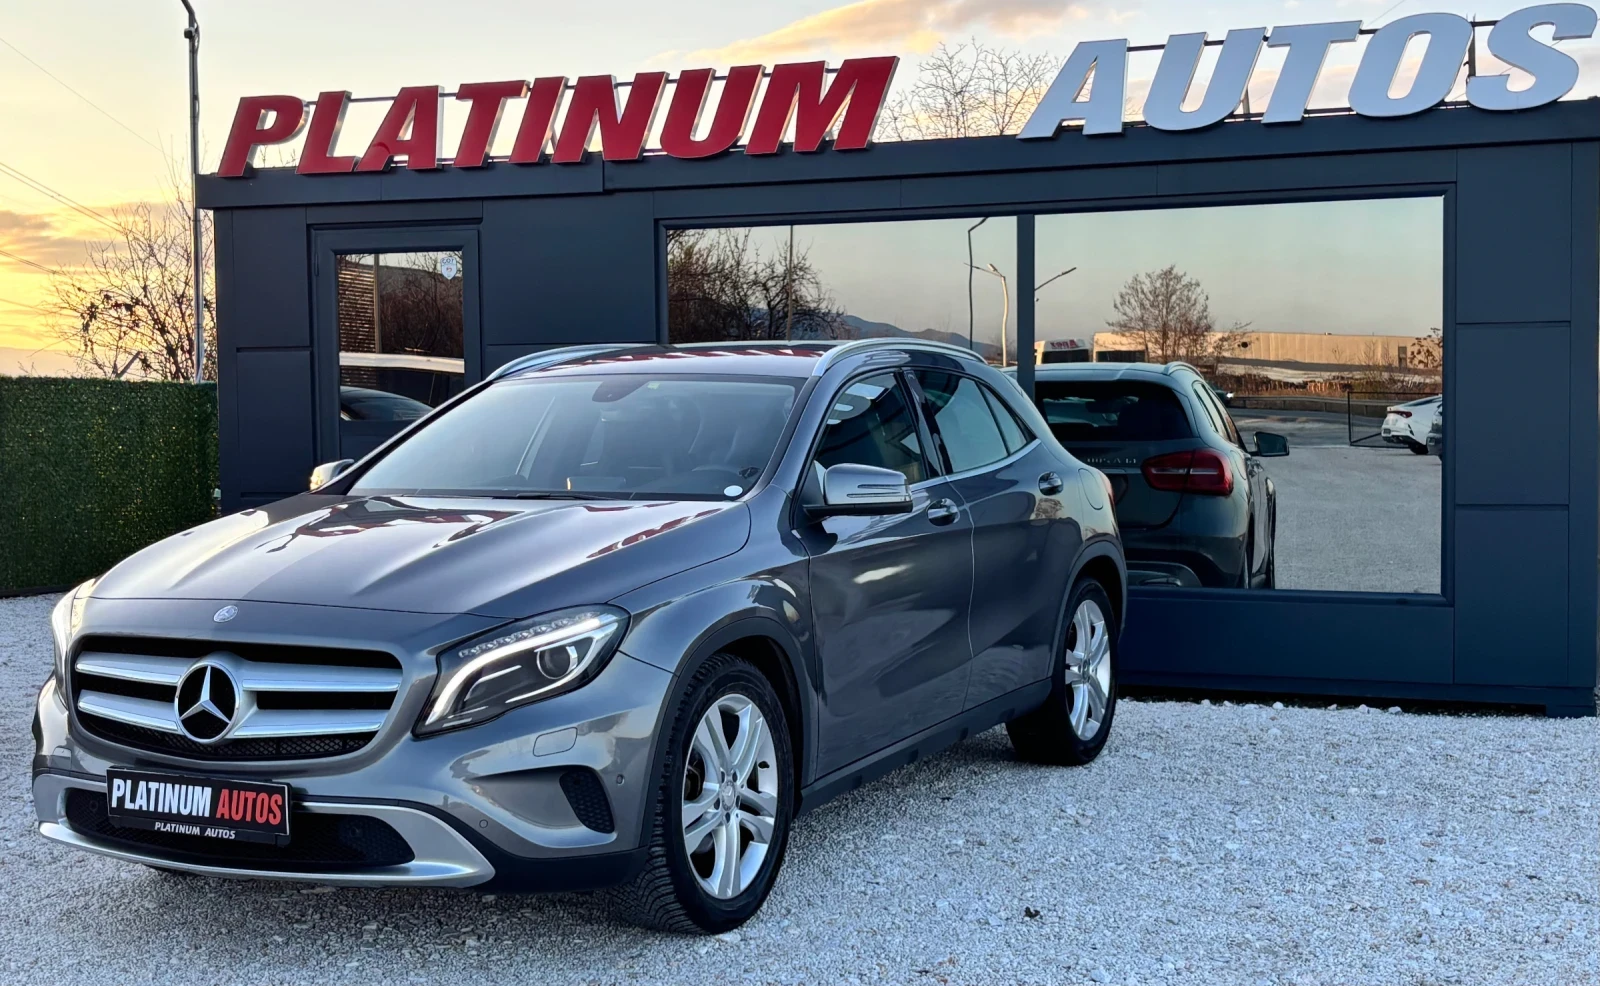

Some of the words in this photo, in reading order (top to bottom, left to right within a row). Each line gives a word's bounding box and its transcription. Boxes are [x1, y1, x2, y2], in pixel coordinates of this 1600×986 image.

[217, 56, 900, 178] PLATINUM
[1016, 3, 1598, 140] AUTOS
[111, 778, 212, 817] PLATINUM
[216, 789, 282, 826] AUTOS
[154, 821, 200, 836] PLATINUM
[204, 827, 236, 840] AUTOS
